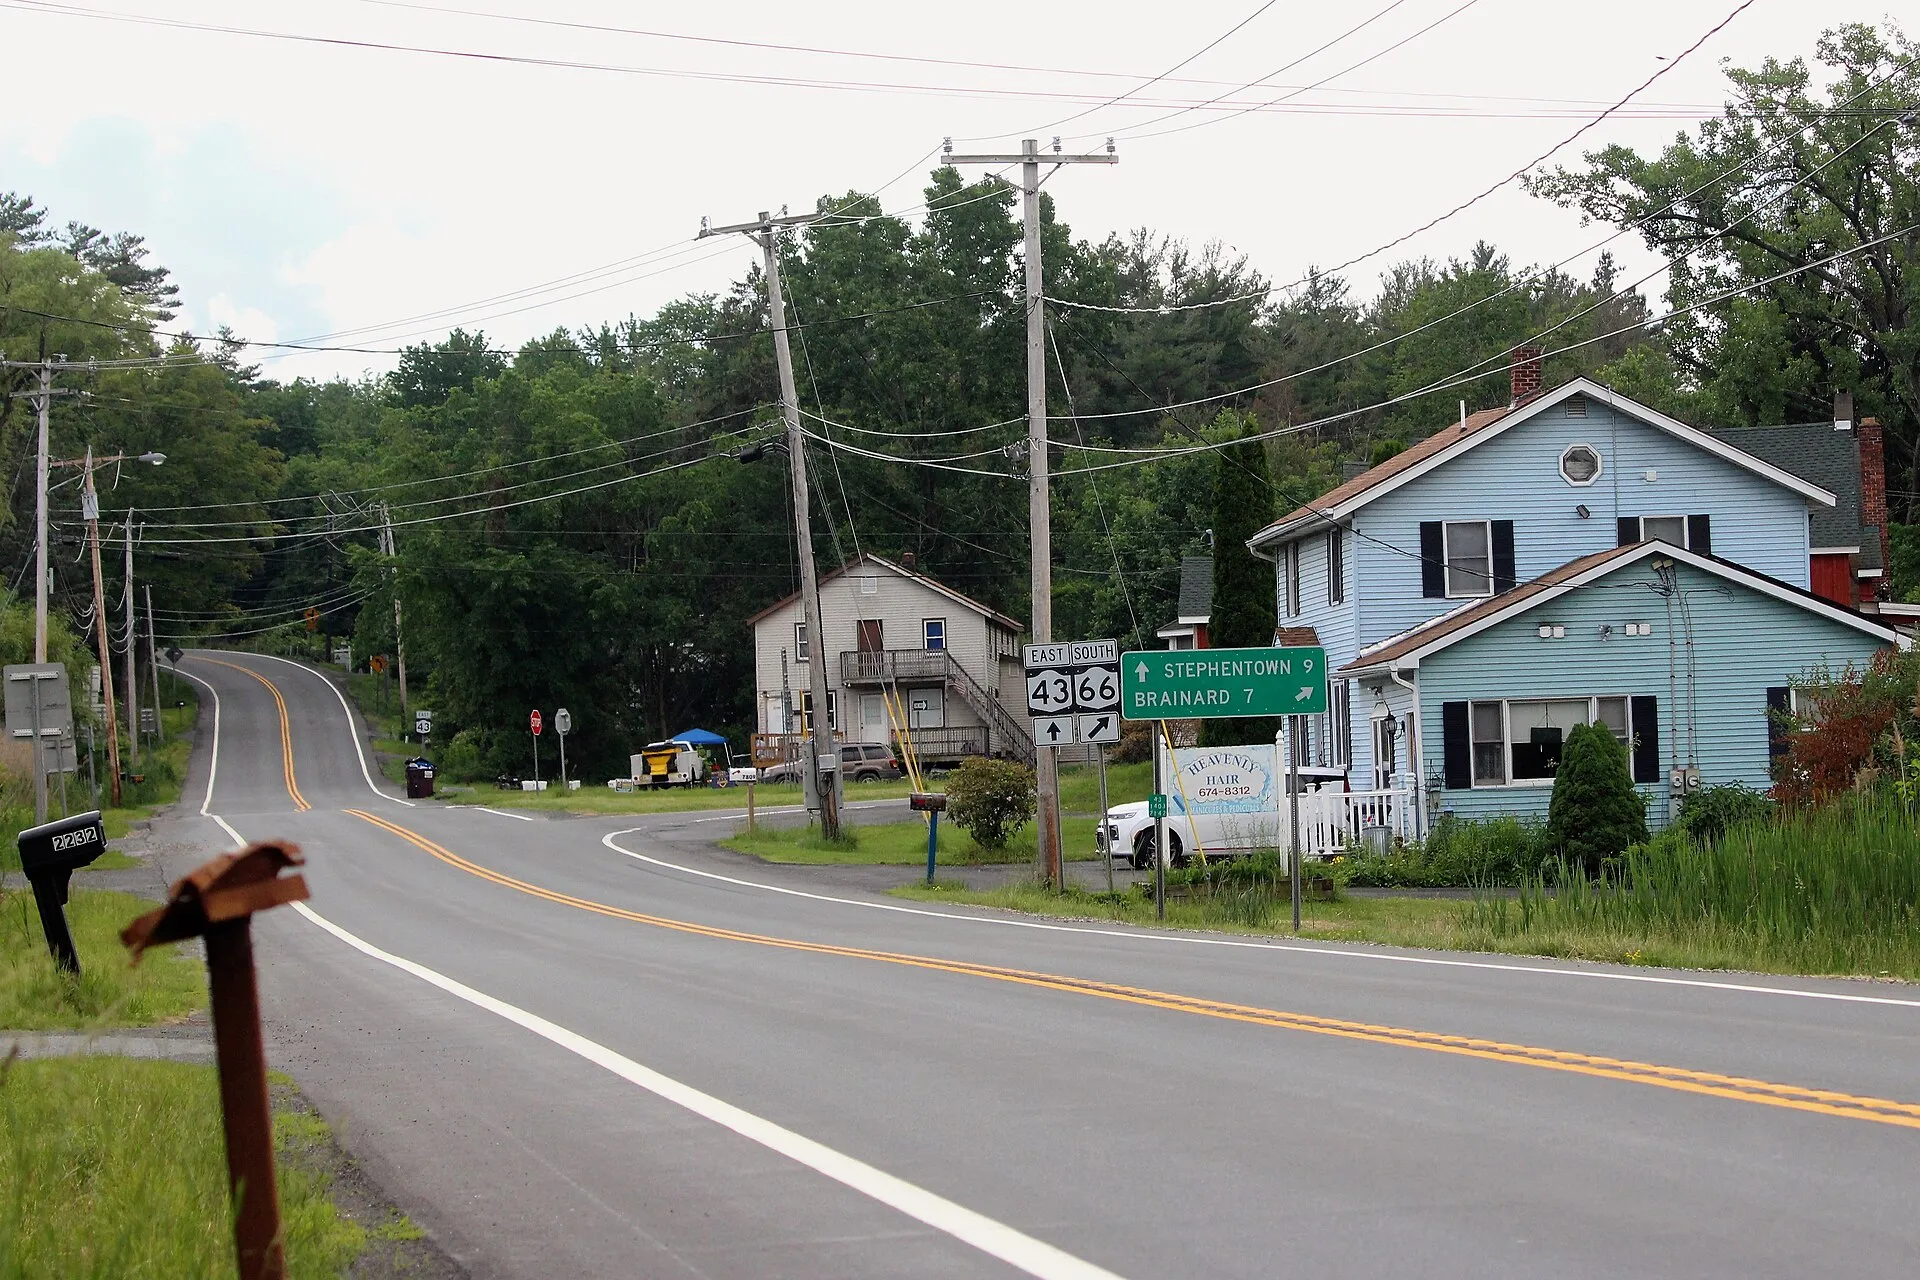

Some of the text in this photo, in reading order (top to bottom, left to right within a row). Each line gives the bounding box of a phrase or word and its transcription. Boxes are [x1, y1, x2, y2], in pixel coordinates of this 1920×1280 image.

[1031, 648, 1063, 663] EAST
[1074, 644, 1114, 660] SOUTH
[1164, 659, 1314, 679] STEPHENTOWN 9
[1031, 678, 1069, 705] 43
[1079, 675, 1116, 702] 66
[1134, 688, 1254, 708] BRAINARD 7
[417, 722, 430, 732] 43
[1188, 753, 1258, 776] HEAVENLY
[1206, 774, 1240, 786] HAIR
[1198, 786, 1251, 797] 674-8312
[53, 828, 97, 850] 2232
